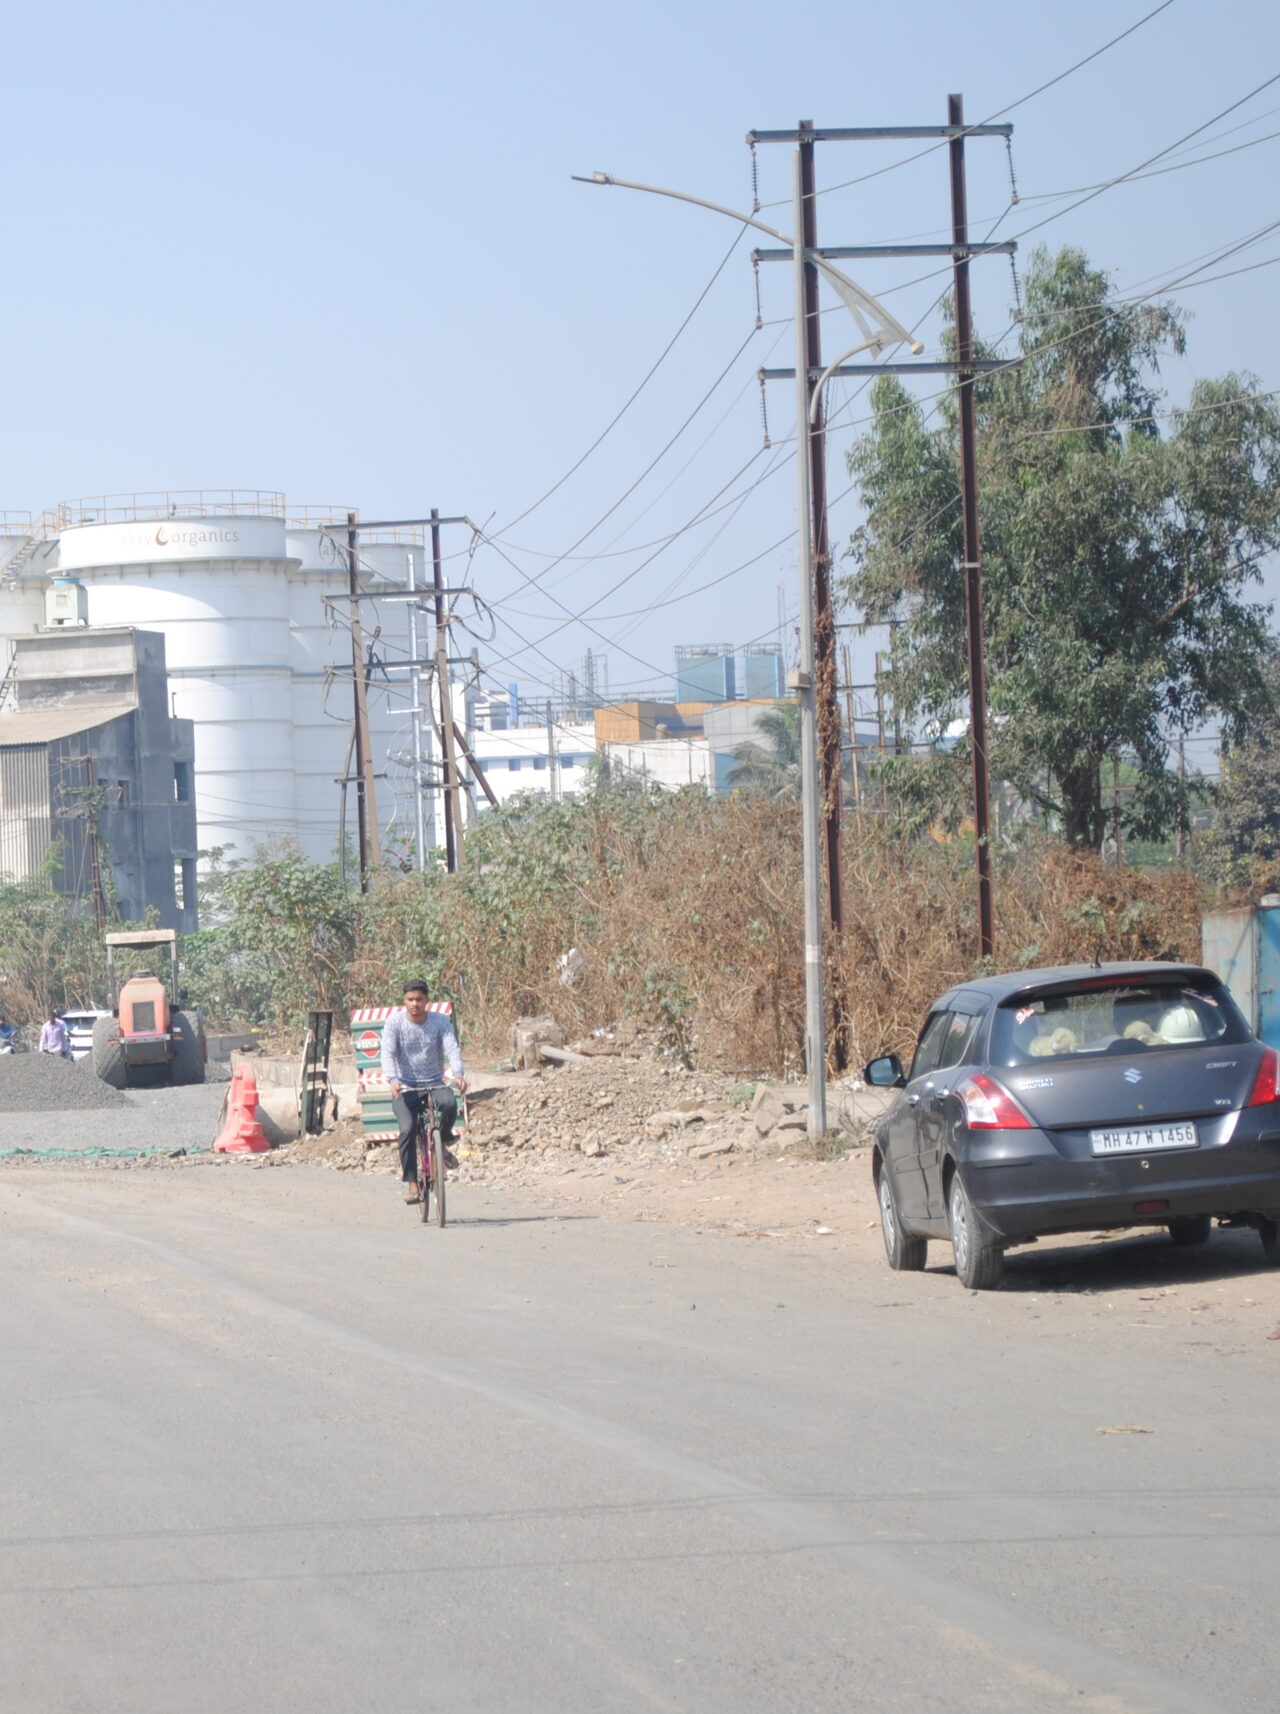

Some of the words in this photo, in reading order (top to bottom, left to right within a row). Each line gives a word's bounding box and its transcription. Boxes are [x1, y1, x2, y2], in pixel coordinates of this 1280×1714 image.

[171, 530, 240, 546] organics
[1102, 1132, 1121, 1149] MH
[1125, 1131, 1140, 1146] 47
[1158, 1125, 1194, 1143] 1456
